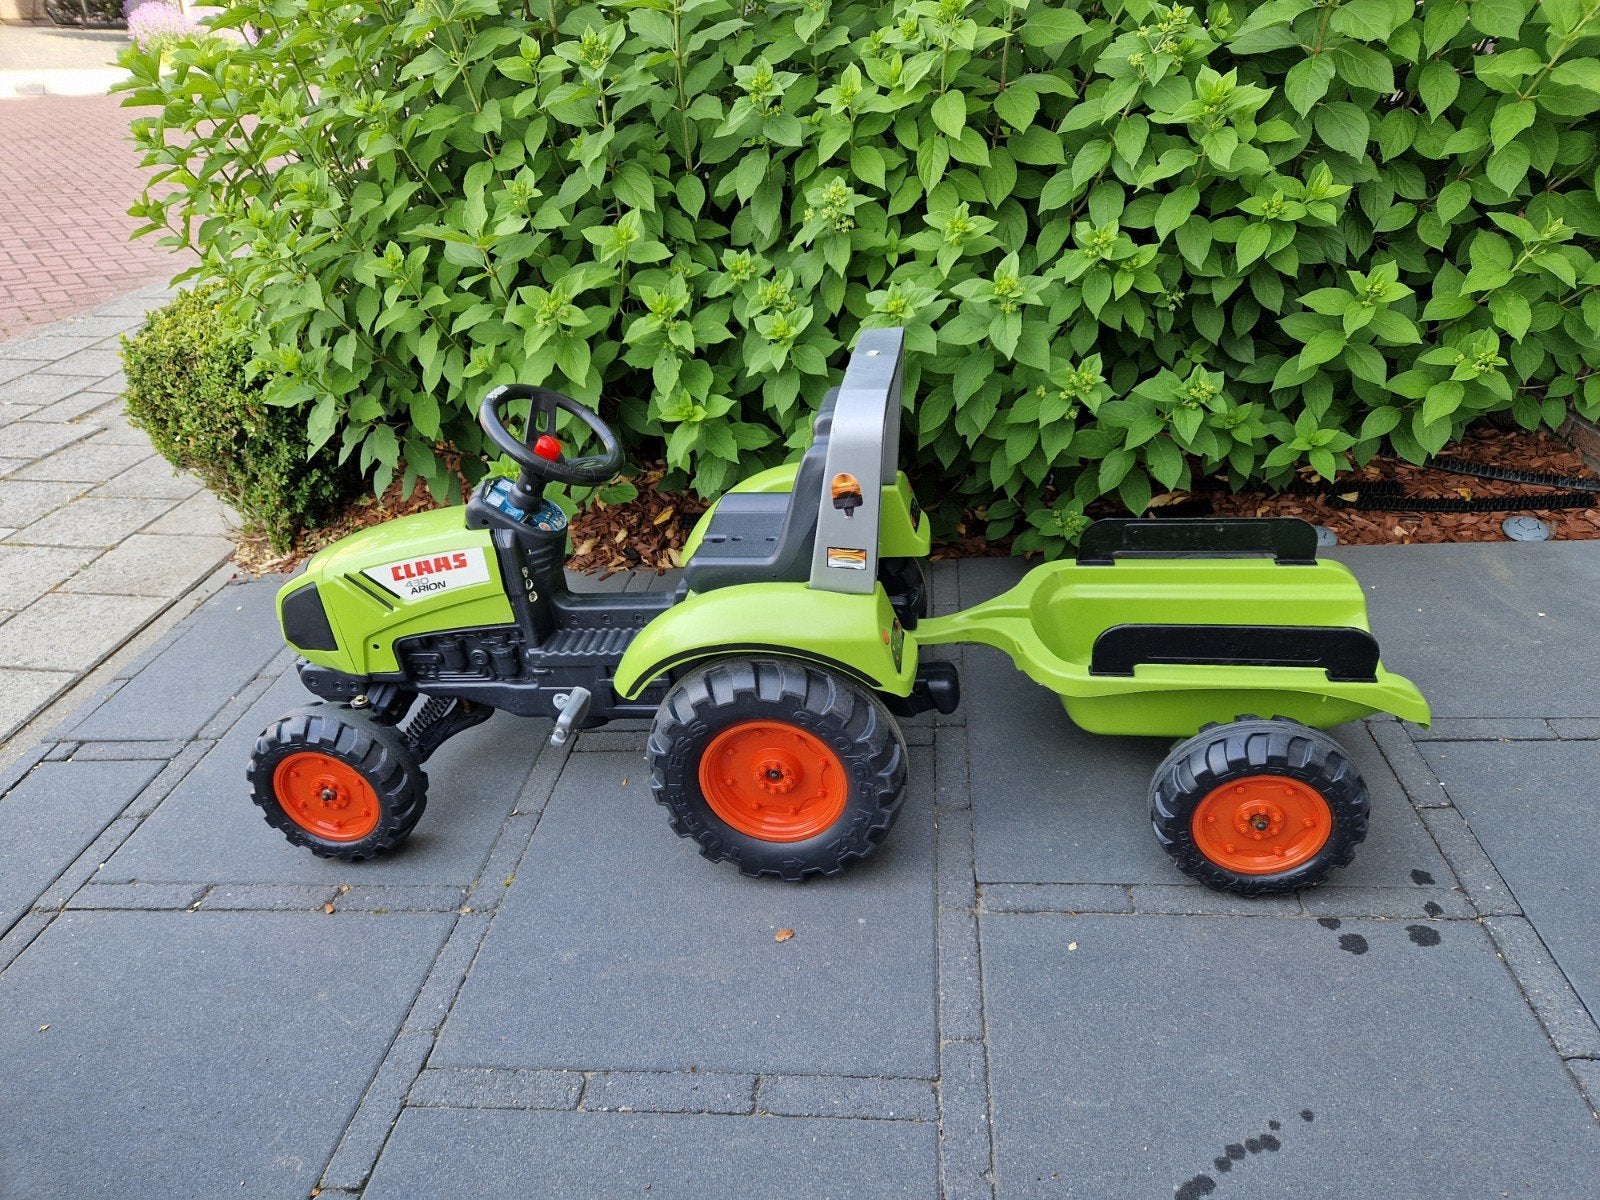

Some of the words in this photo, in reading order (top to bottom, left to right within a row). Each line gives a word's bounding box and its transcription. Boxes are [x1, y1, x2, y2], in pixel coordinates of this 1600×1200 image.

[391, 553, 467, 581] CLAAS
[405, 577, 430, 588] 430
[411, 581, 446, 594] ARION
